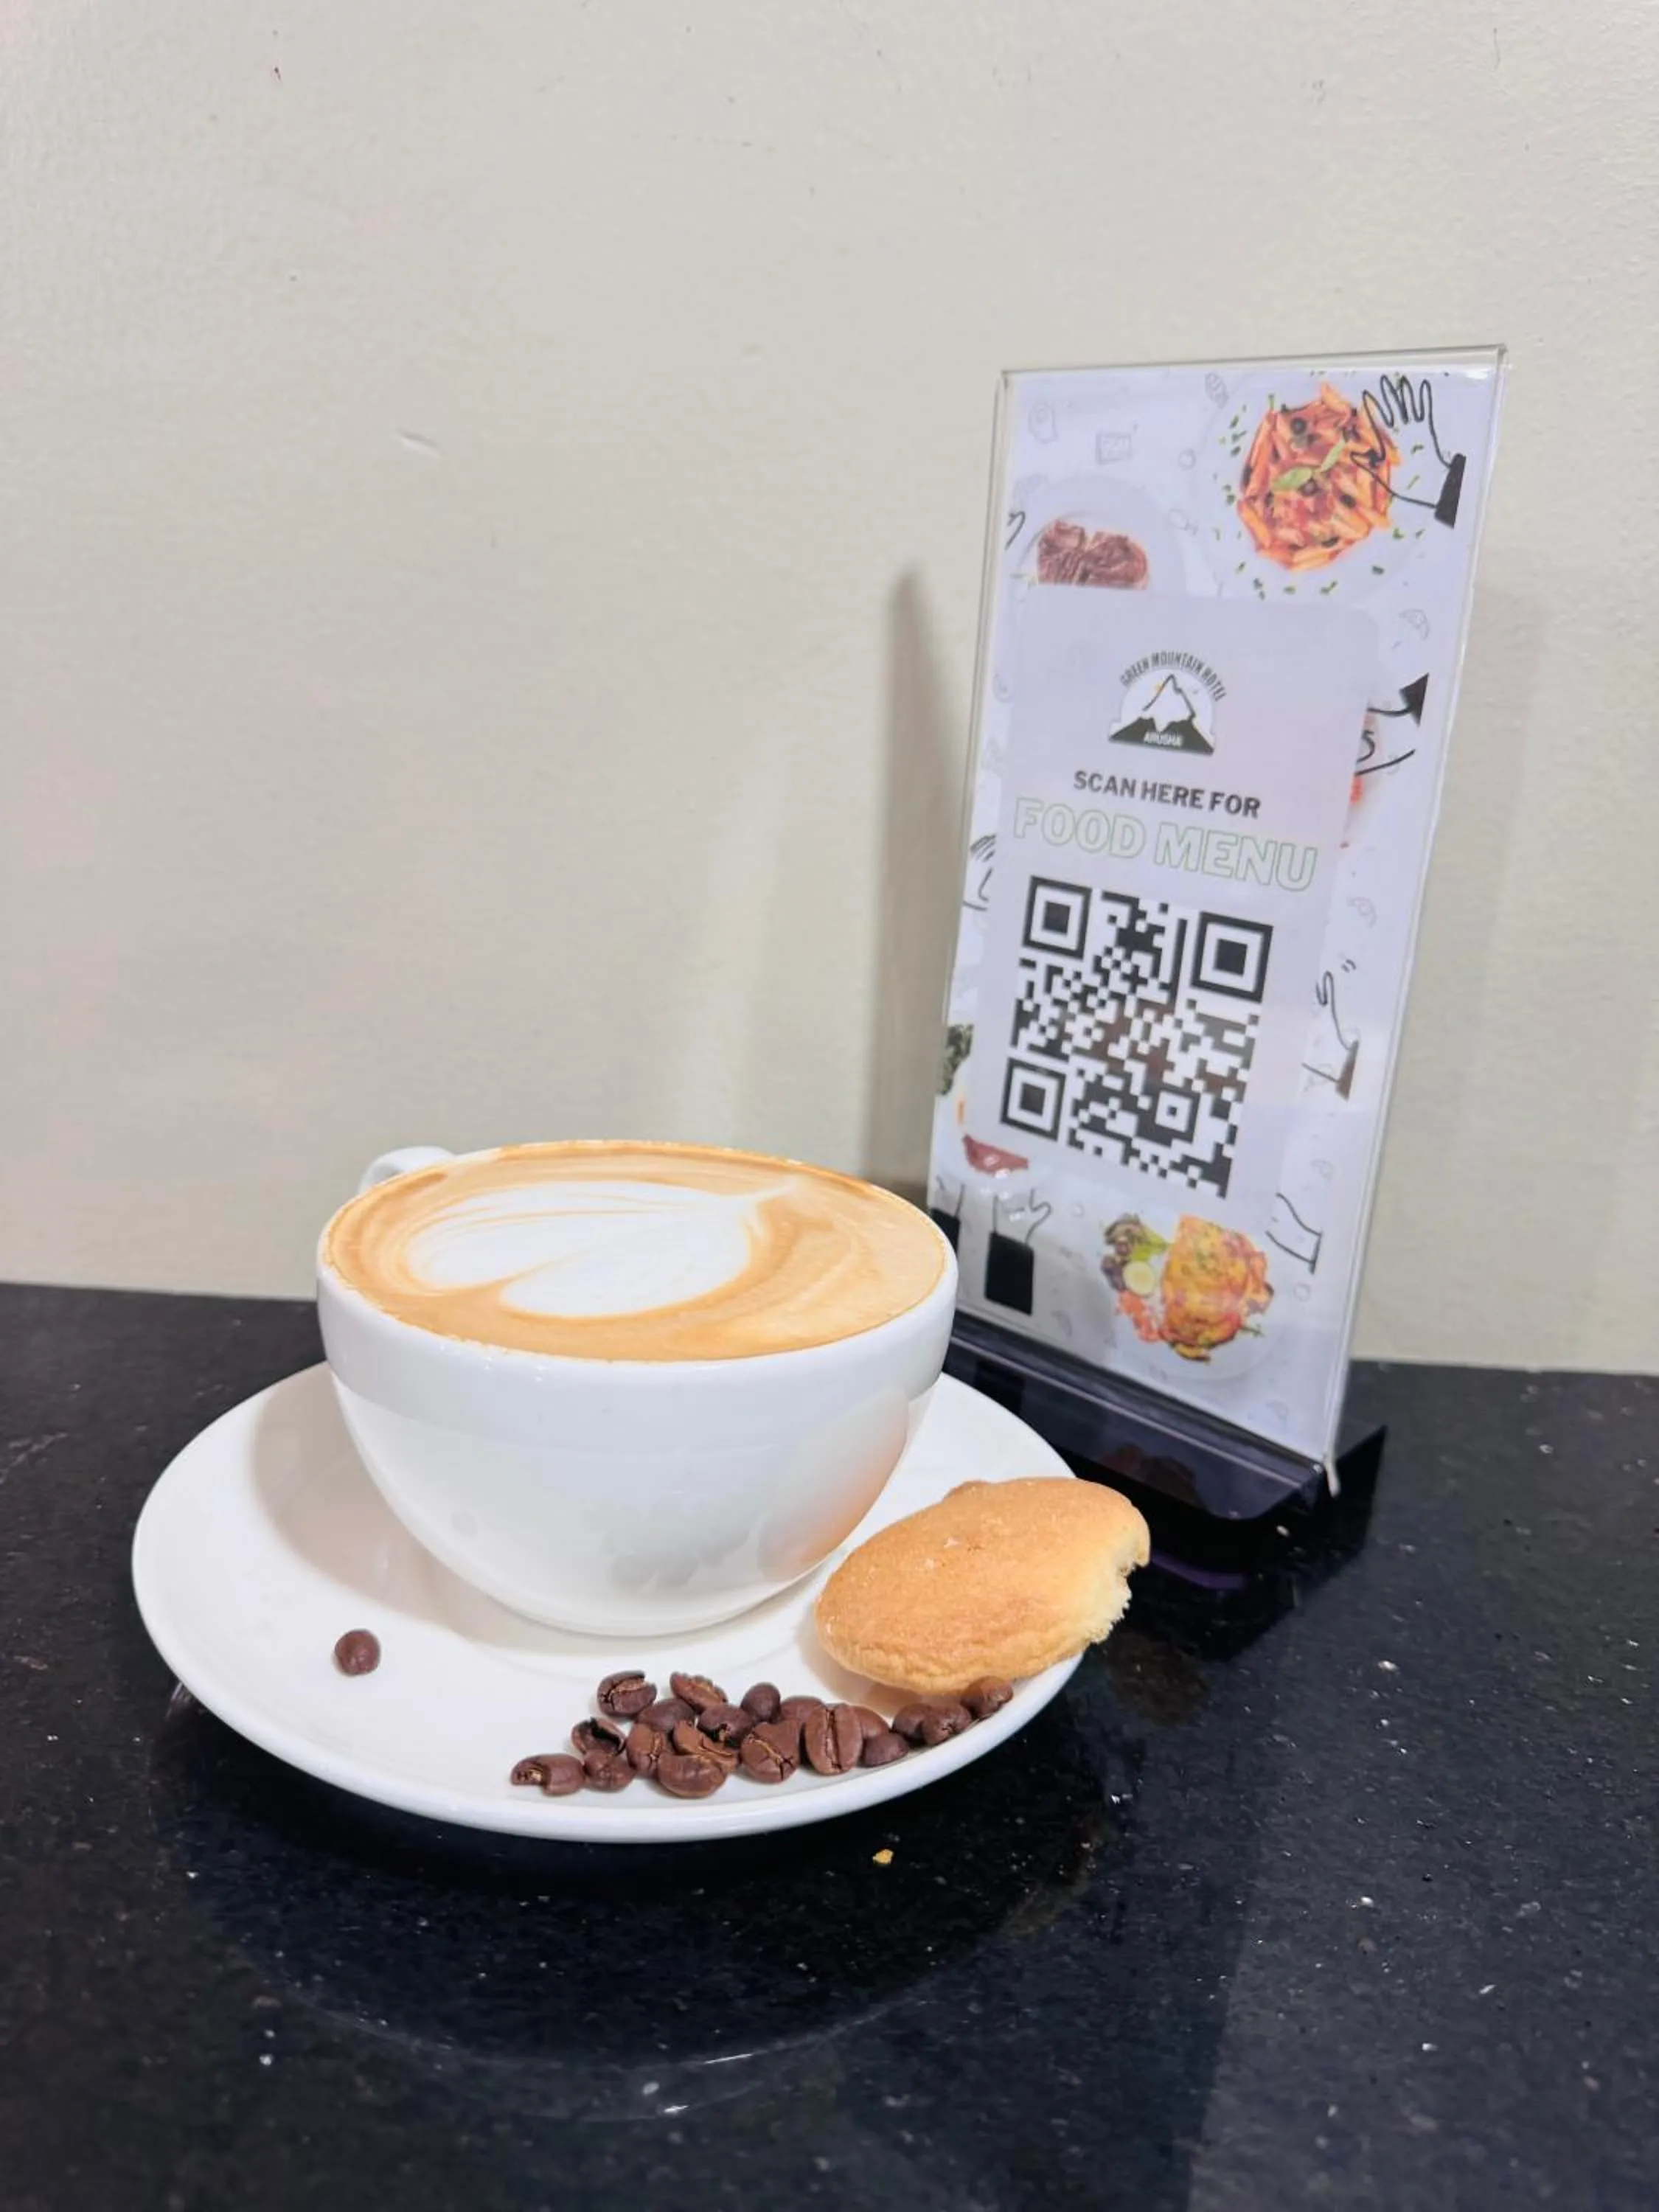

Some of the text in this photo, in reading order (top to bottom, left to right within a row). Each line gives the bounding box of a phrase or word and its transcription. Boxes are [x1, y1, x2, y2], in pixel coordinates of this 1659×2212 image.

[1120, 651, 1227, 702] GREEN MOUNTAIN HOTEL
[1074, 771, 1261, 818] SCAN HERE FOR
[1013, 796, 1318, 892] FOOD MENU
